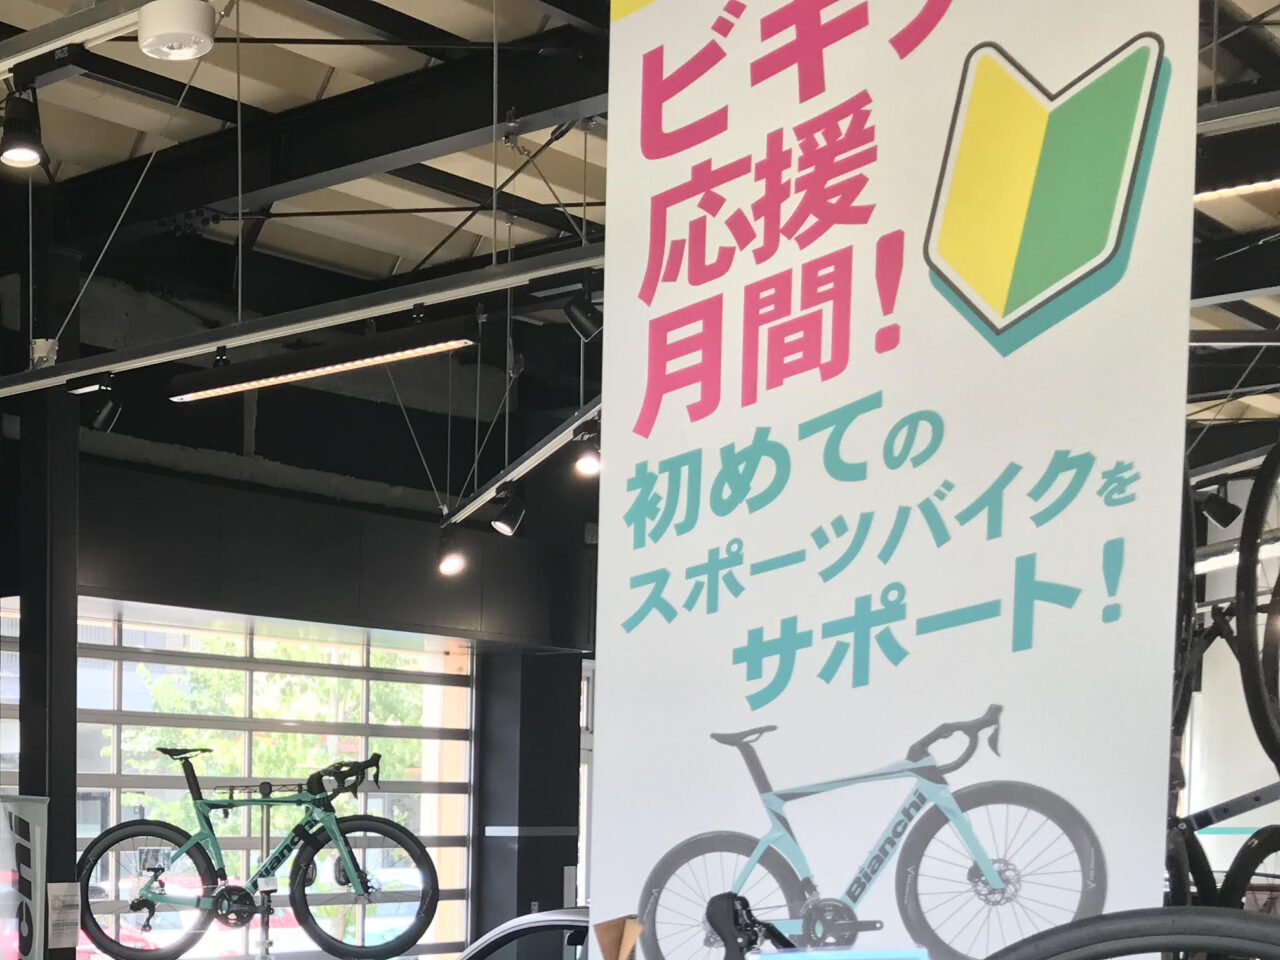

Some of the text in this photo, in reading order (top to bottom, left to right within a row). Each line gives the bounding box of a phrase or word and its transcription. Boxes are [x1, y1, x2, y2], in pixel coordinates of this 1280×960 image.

[638, 89, 878, 307] 応援
[620, 447, 1142, 634] スポーツバイクを
[621, 389, 946, 551] 初めての
[846, 789, 928, 903] Bianchi
